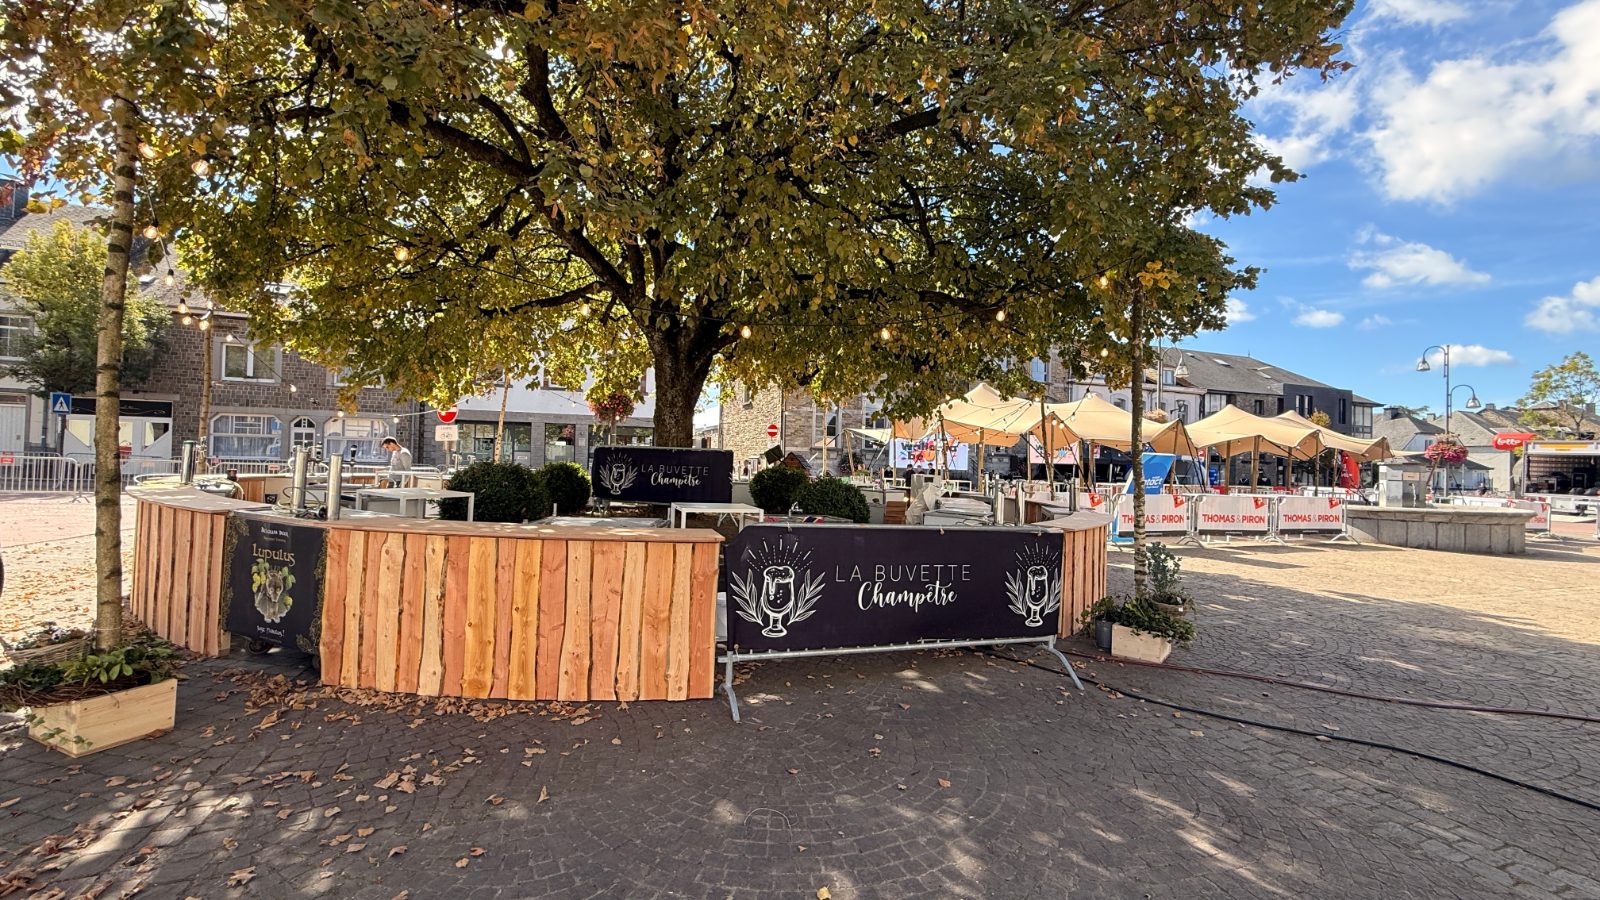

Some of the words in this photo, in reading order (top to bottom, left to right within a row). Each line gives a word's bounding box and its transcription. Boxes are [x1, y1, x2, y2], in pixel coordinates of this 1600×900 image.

[641, 465, 654, 473] LA
[660, 465, 709, 476] BUVETTE
[1122, 514, 1155, 524] THAS
[1162, 514, 1185, 524] PIRON
[1202, 514, 1235, 524] THOMAS
[1242, 515, 1265, 524] PIRON
[1283, 514, 1312, 522] THOMAS
[1318, 514, 1340, 523] PIRON
[835, 564, 862, 582] LA
[875, 564, 972, 582] BUVETTE
[858, 580, 958, 613] Champêtre
